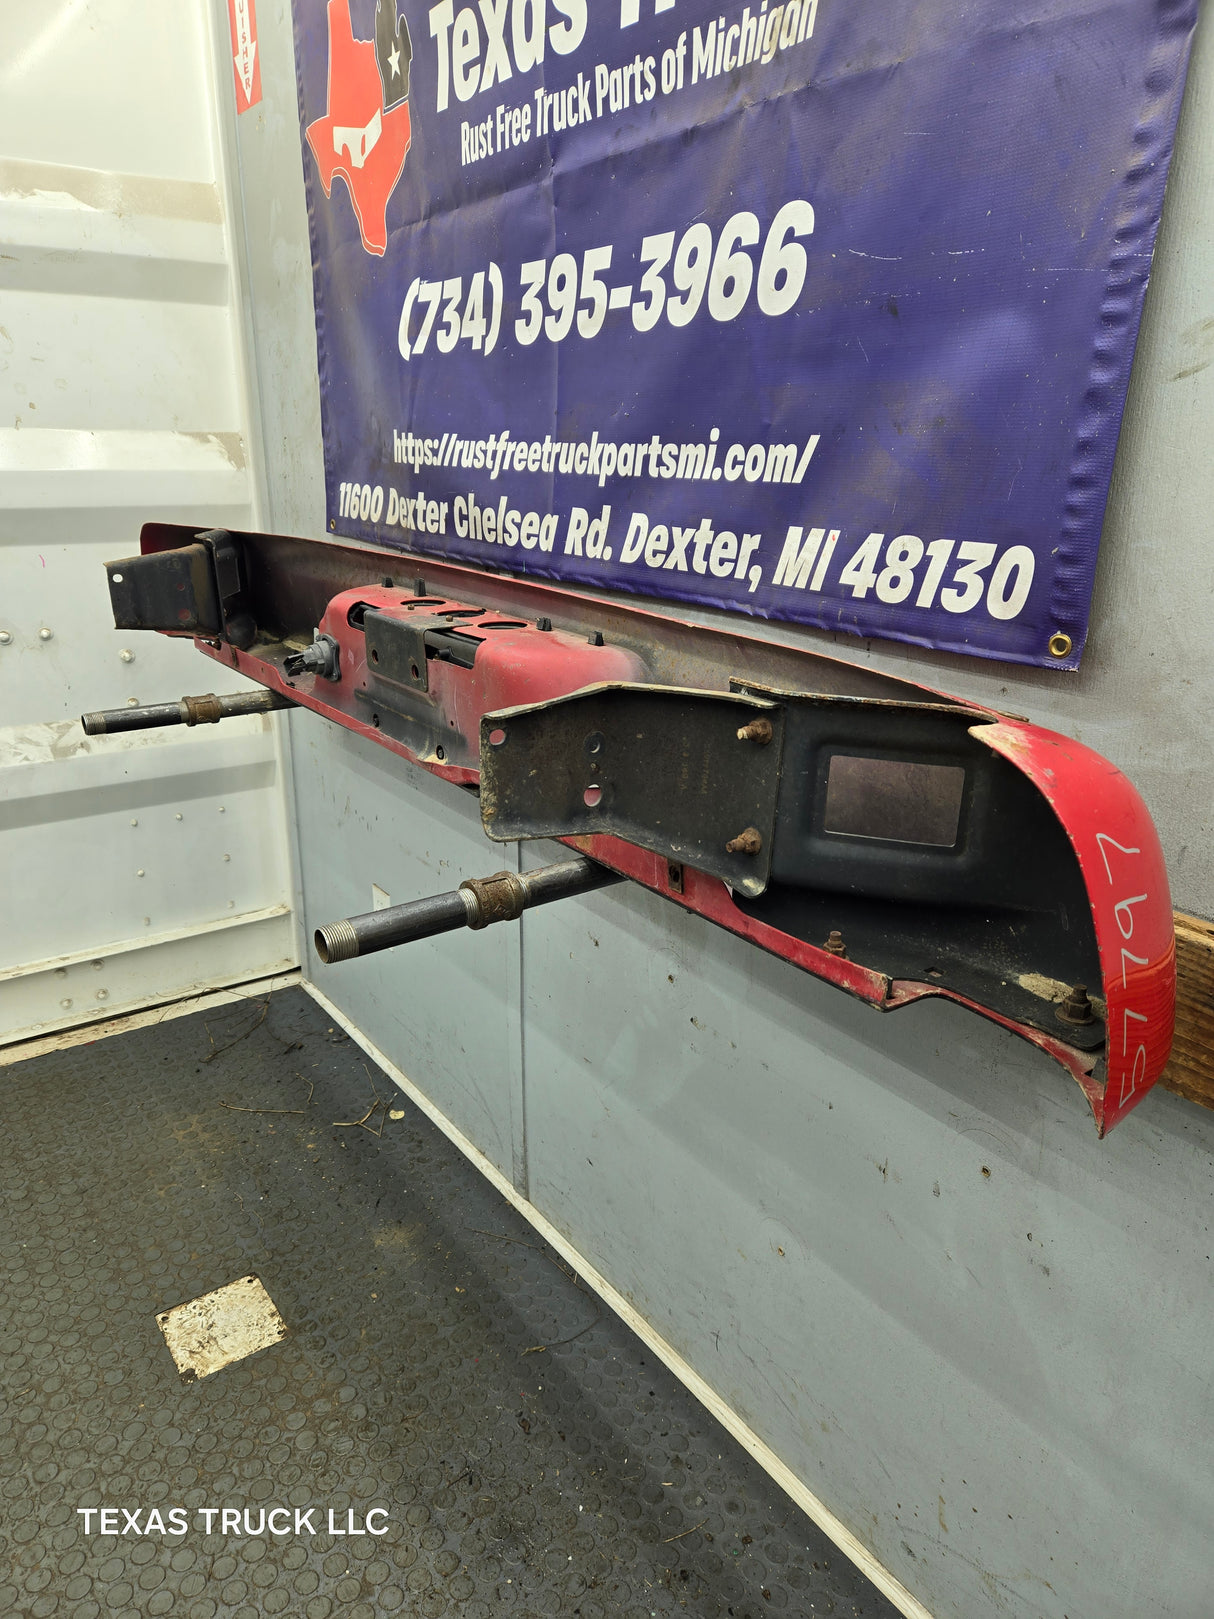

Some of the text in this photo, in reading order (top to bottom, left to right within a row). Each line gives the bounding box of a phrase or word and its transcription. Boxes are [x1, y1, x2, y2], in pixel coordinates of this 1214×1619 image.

[428, 0, 588, 112] Texas
[461, 113, 493, 166] Rust
[496, 100, 531, 152] Free
[535, 73, 592, 137] Truck
[596, 55, 656, 117] Parts
[661, 33, 688, 94] of
[691, 0, 818, 84] Michigan
[398, 200, 815, 362] (734) 395-3966
[393, 427, 820, 487] https://rustfreetruckpartsmi.com/
[338, 482, 1034, 620] 11600 Dexter Chelsea Rd. Dexter, MI 48130
